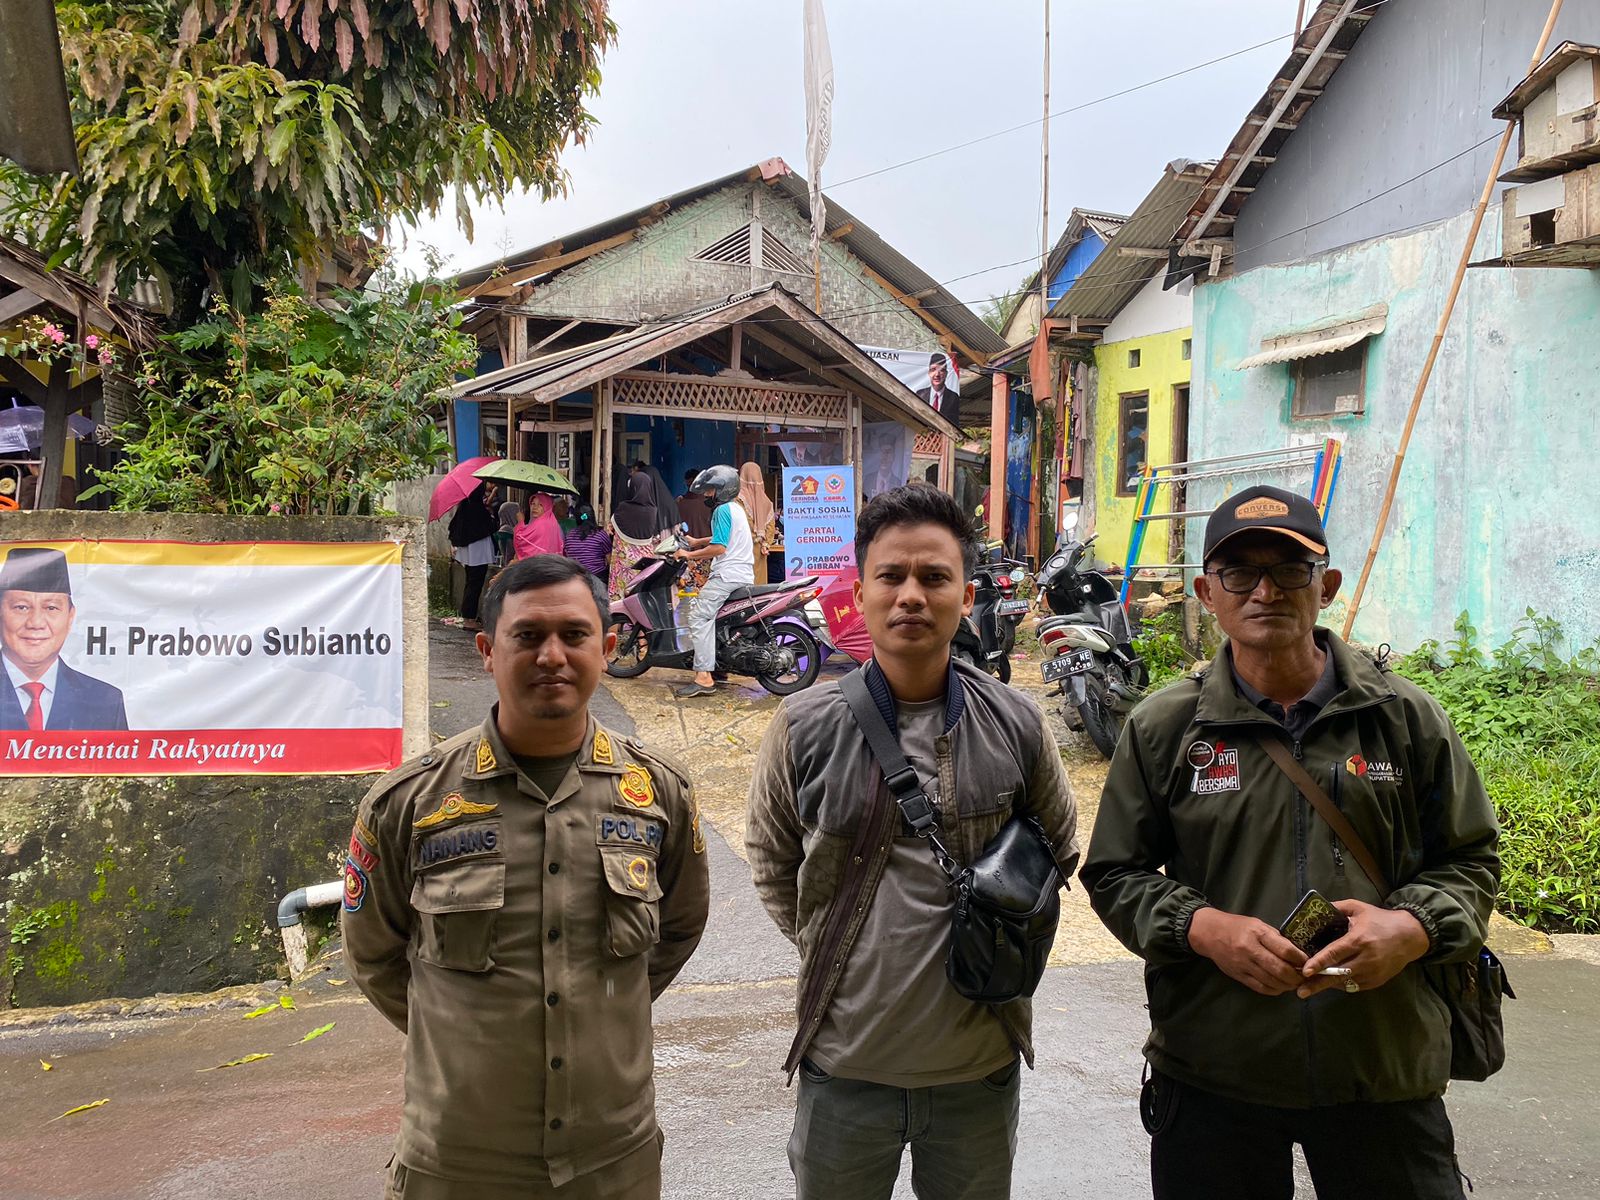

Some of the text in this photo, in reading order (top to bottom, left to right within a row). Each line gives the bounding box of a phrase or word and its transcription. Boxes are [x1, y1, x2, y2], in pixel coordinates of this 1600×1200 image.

[1238, 504, 1287, 515] CONVERSE
[790, 556, 804, 577] 2
[86, 625, 392, 656] H. Prabowo Subianto
[1052, 657, 1071, 669] 5709
[5, 738, 286, 764] Mencintai Rakyatnya
[1218, 752, 1236, 766] AYO
[1199, 776, 1238, 792] BERSAMA
[602, 818, 643, 842] POL
[420, 830, 497, 864] NANANG
